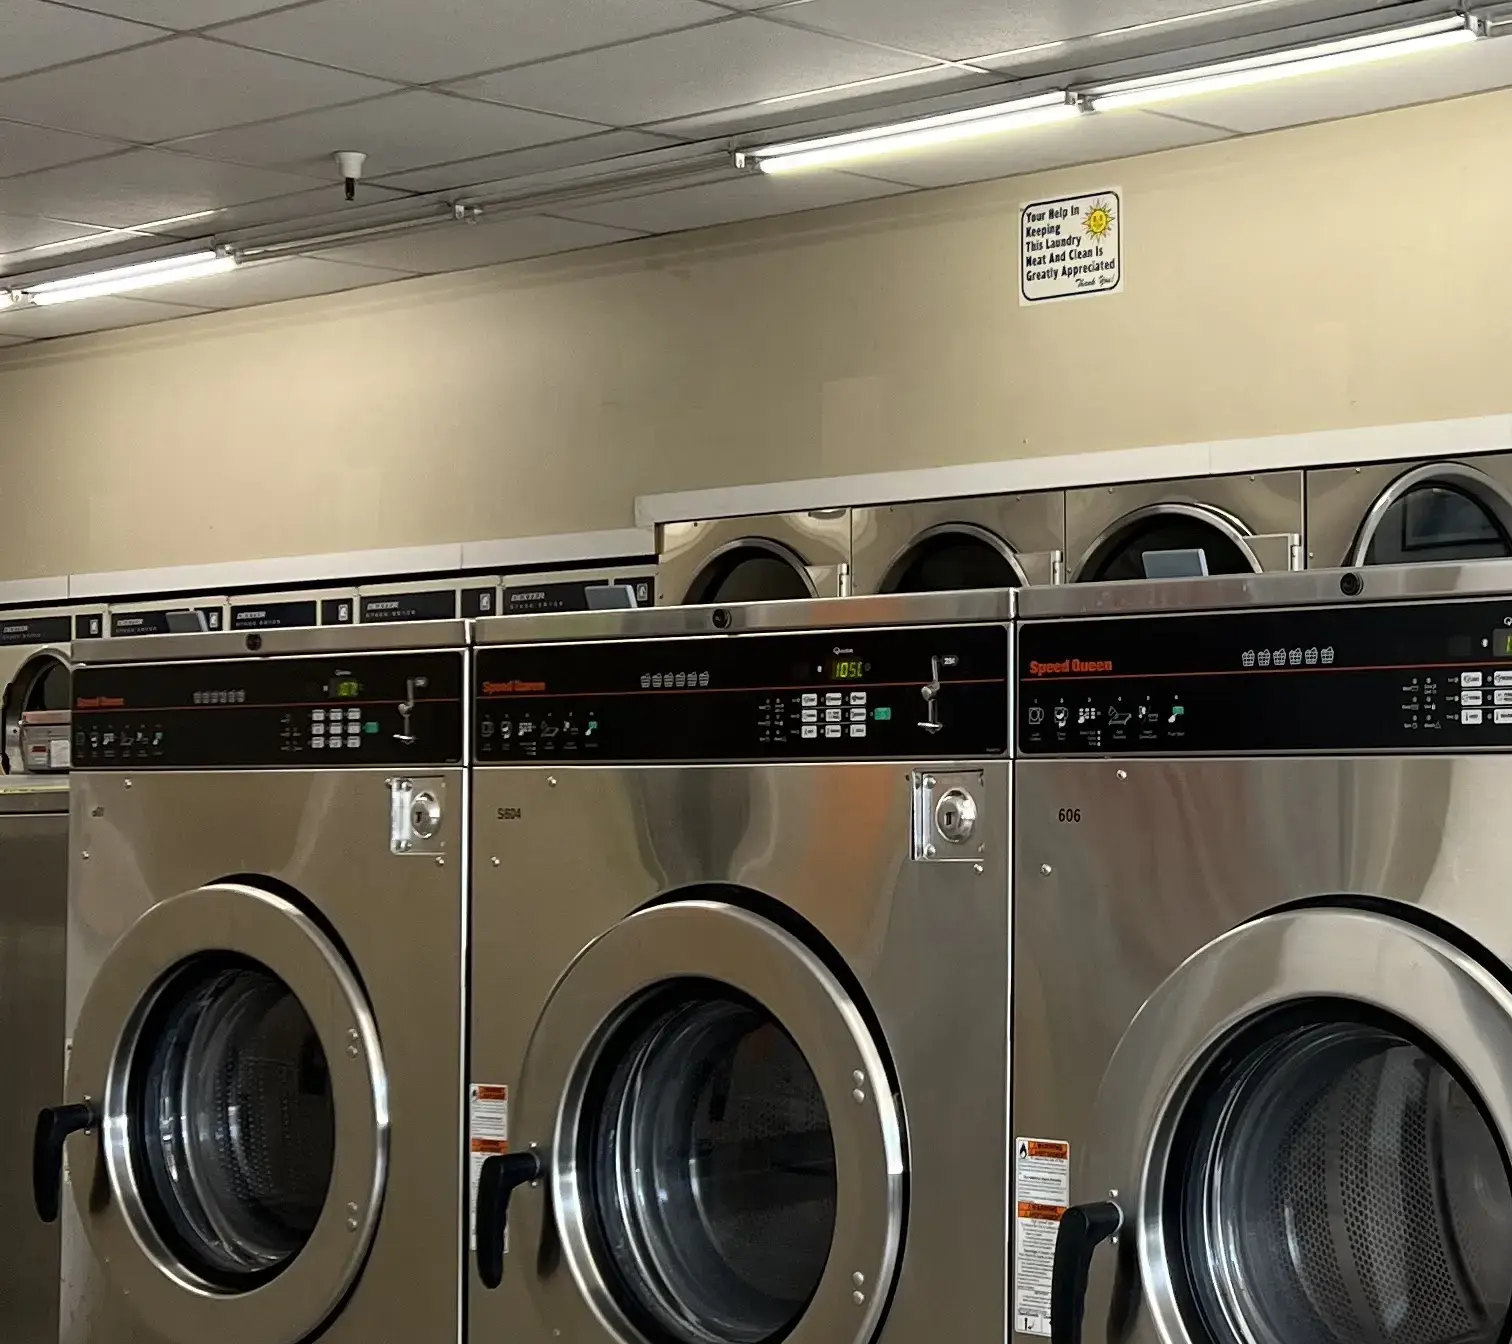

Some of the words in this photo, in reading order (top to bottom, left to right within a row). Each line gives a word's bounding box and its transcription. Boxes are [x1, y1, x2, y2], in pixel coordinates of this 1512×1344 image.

[1026, 212, 1046, 223] Your
[1048, 207, 1067, 220] Help
[1071, 205, 1080, 216] In
[1026, 224, 1061, 238] Keeping
[1026, 240, 1043, 252] This
[1046, 235, 1082, 249] Laundry
[1026, 256, 1046, 267] Neat
[1049, 251, 1066, 264] And
[1069, 248, 1093, 260] Clean
[1096, 246, 1103, 257] Is
[1026, 268, 1059, 281] Greatly
[1061, 258, 1115, 277] Appreciated
[1075, 277, 1096, 288] Thank
[1030, 659, 1070, 676] Speed
[1071, 658, 1113, 672] Queen
[1058, 808, 1081, 823] 606
